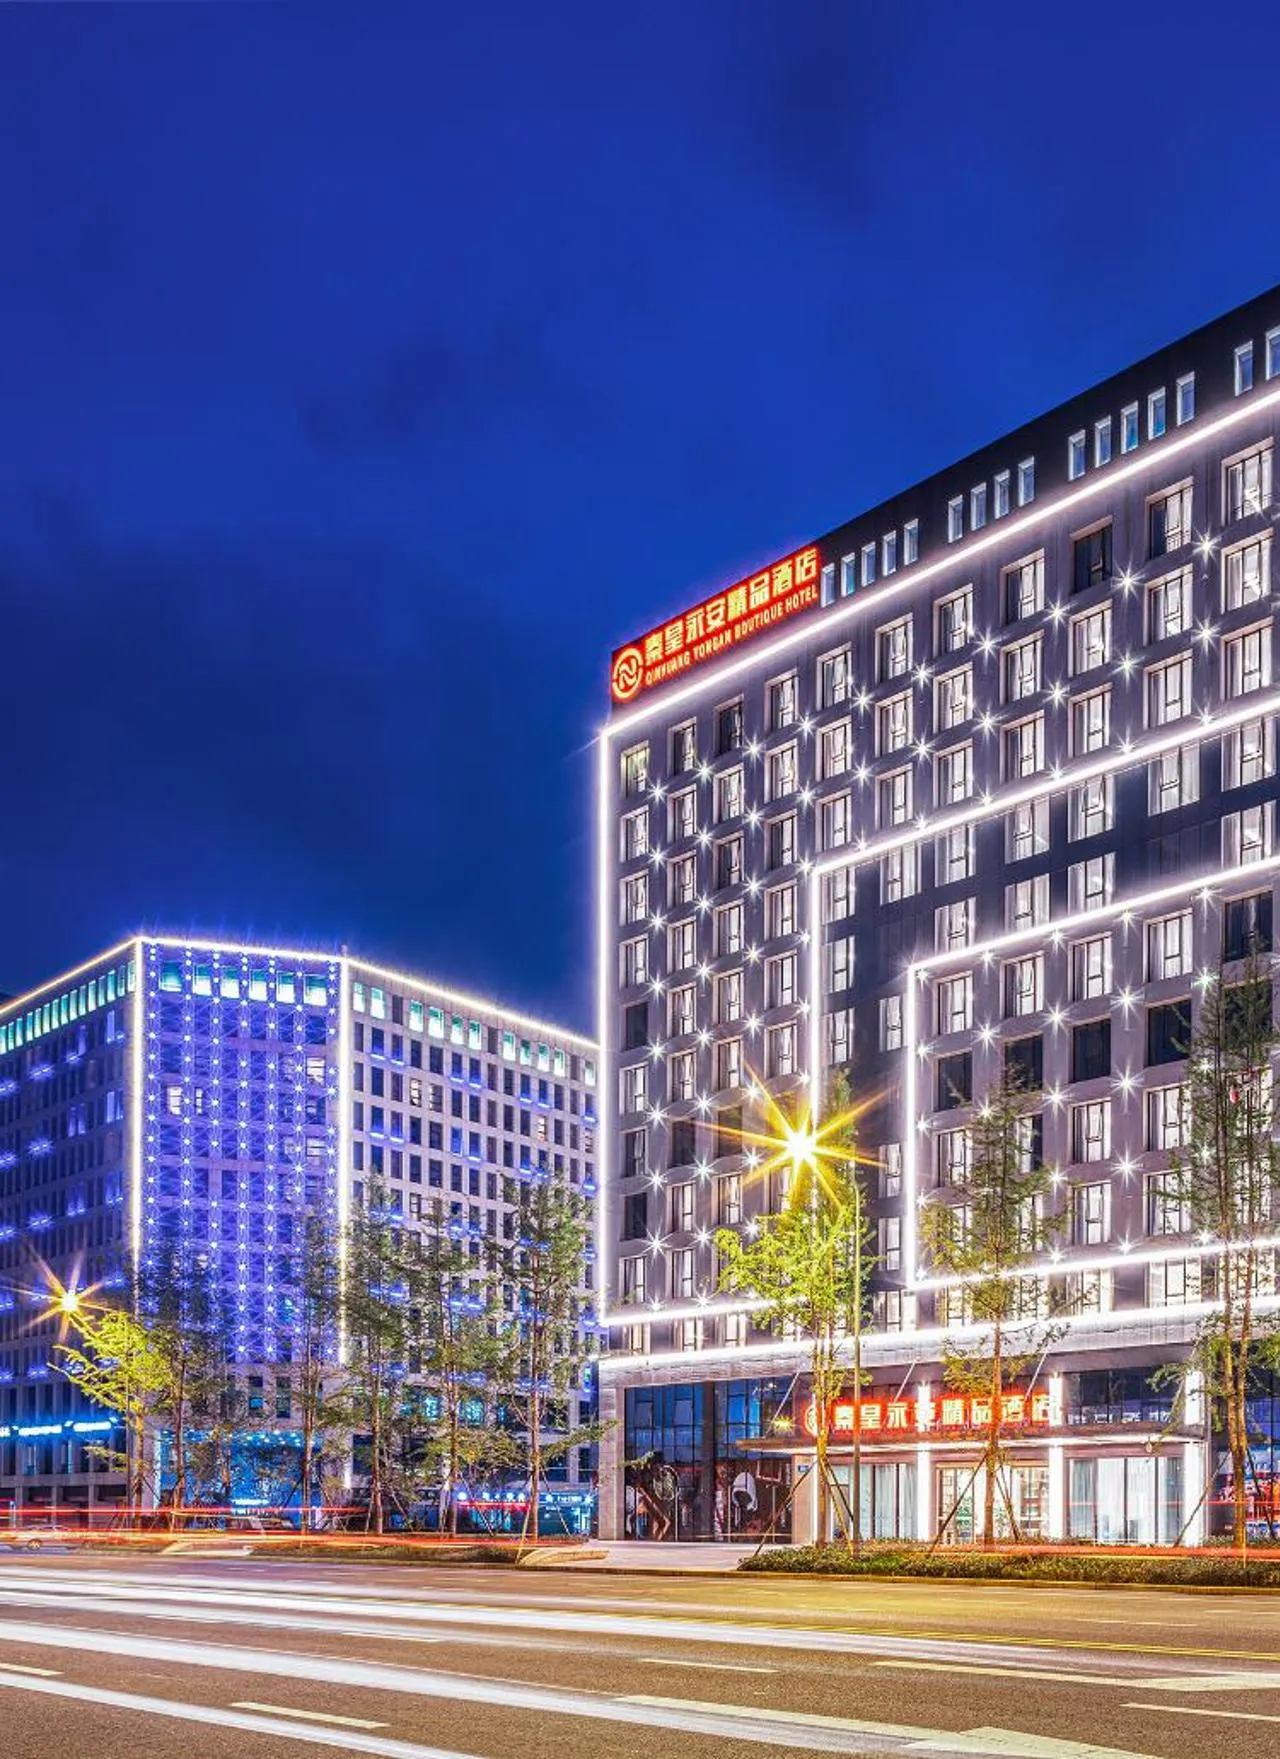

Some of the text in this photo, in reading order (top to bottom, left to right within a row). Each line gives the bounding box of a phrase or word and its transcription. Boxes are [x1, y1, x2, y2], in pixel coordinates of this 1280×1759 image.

[645, 548, 817, 666] 秦皇永安精品酒店
[693, 629, 732, 660] YONGAN
[734, 602, 784, 640] BOUTIQUE
[785, 584, 818, 613] HOTEL
